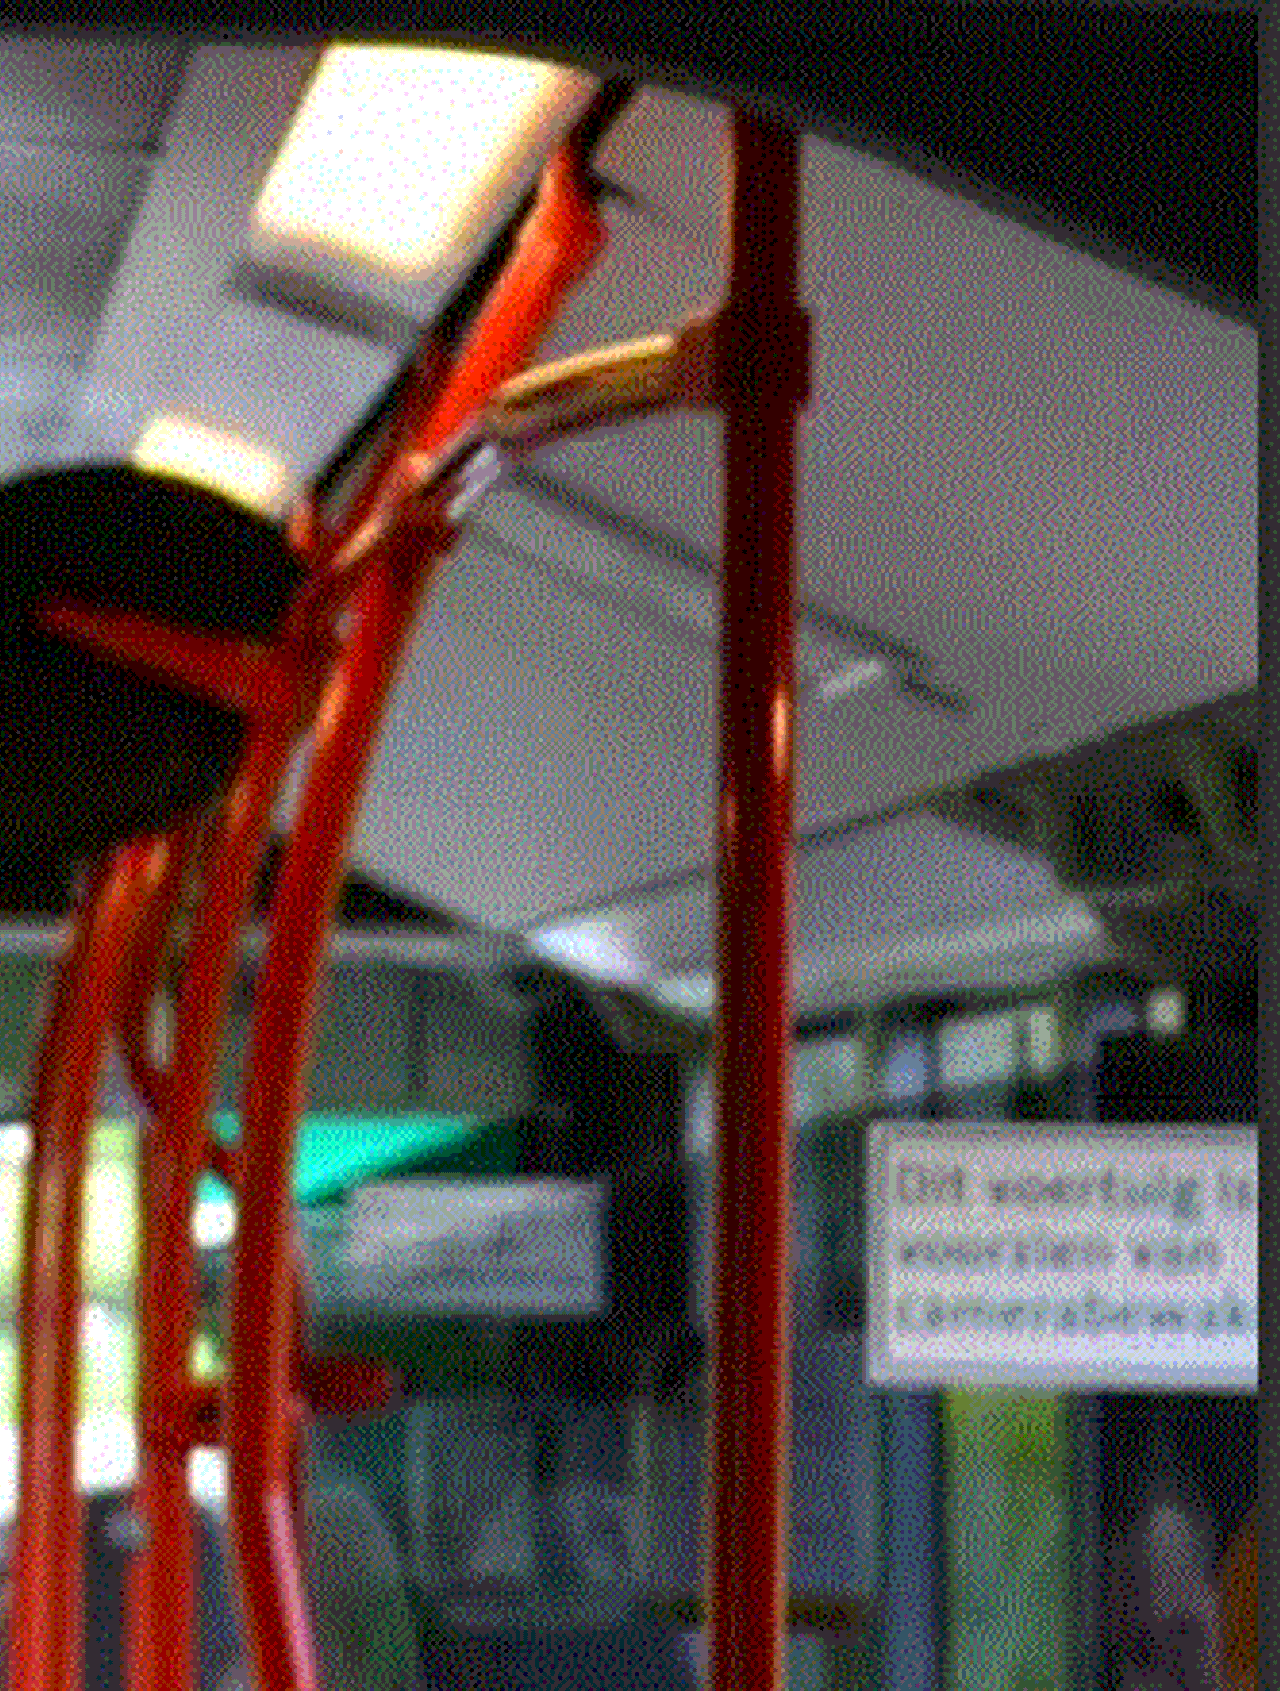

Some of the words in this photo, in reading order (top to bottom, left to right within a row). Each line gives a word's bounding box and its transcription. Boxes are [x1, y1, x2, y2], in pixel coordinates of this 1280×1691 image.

[897, 1161, 966, 1206] Dit
[988, 1166, 1200, 1222] voertuig
[1132, 1238, 1224, 1272] van
